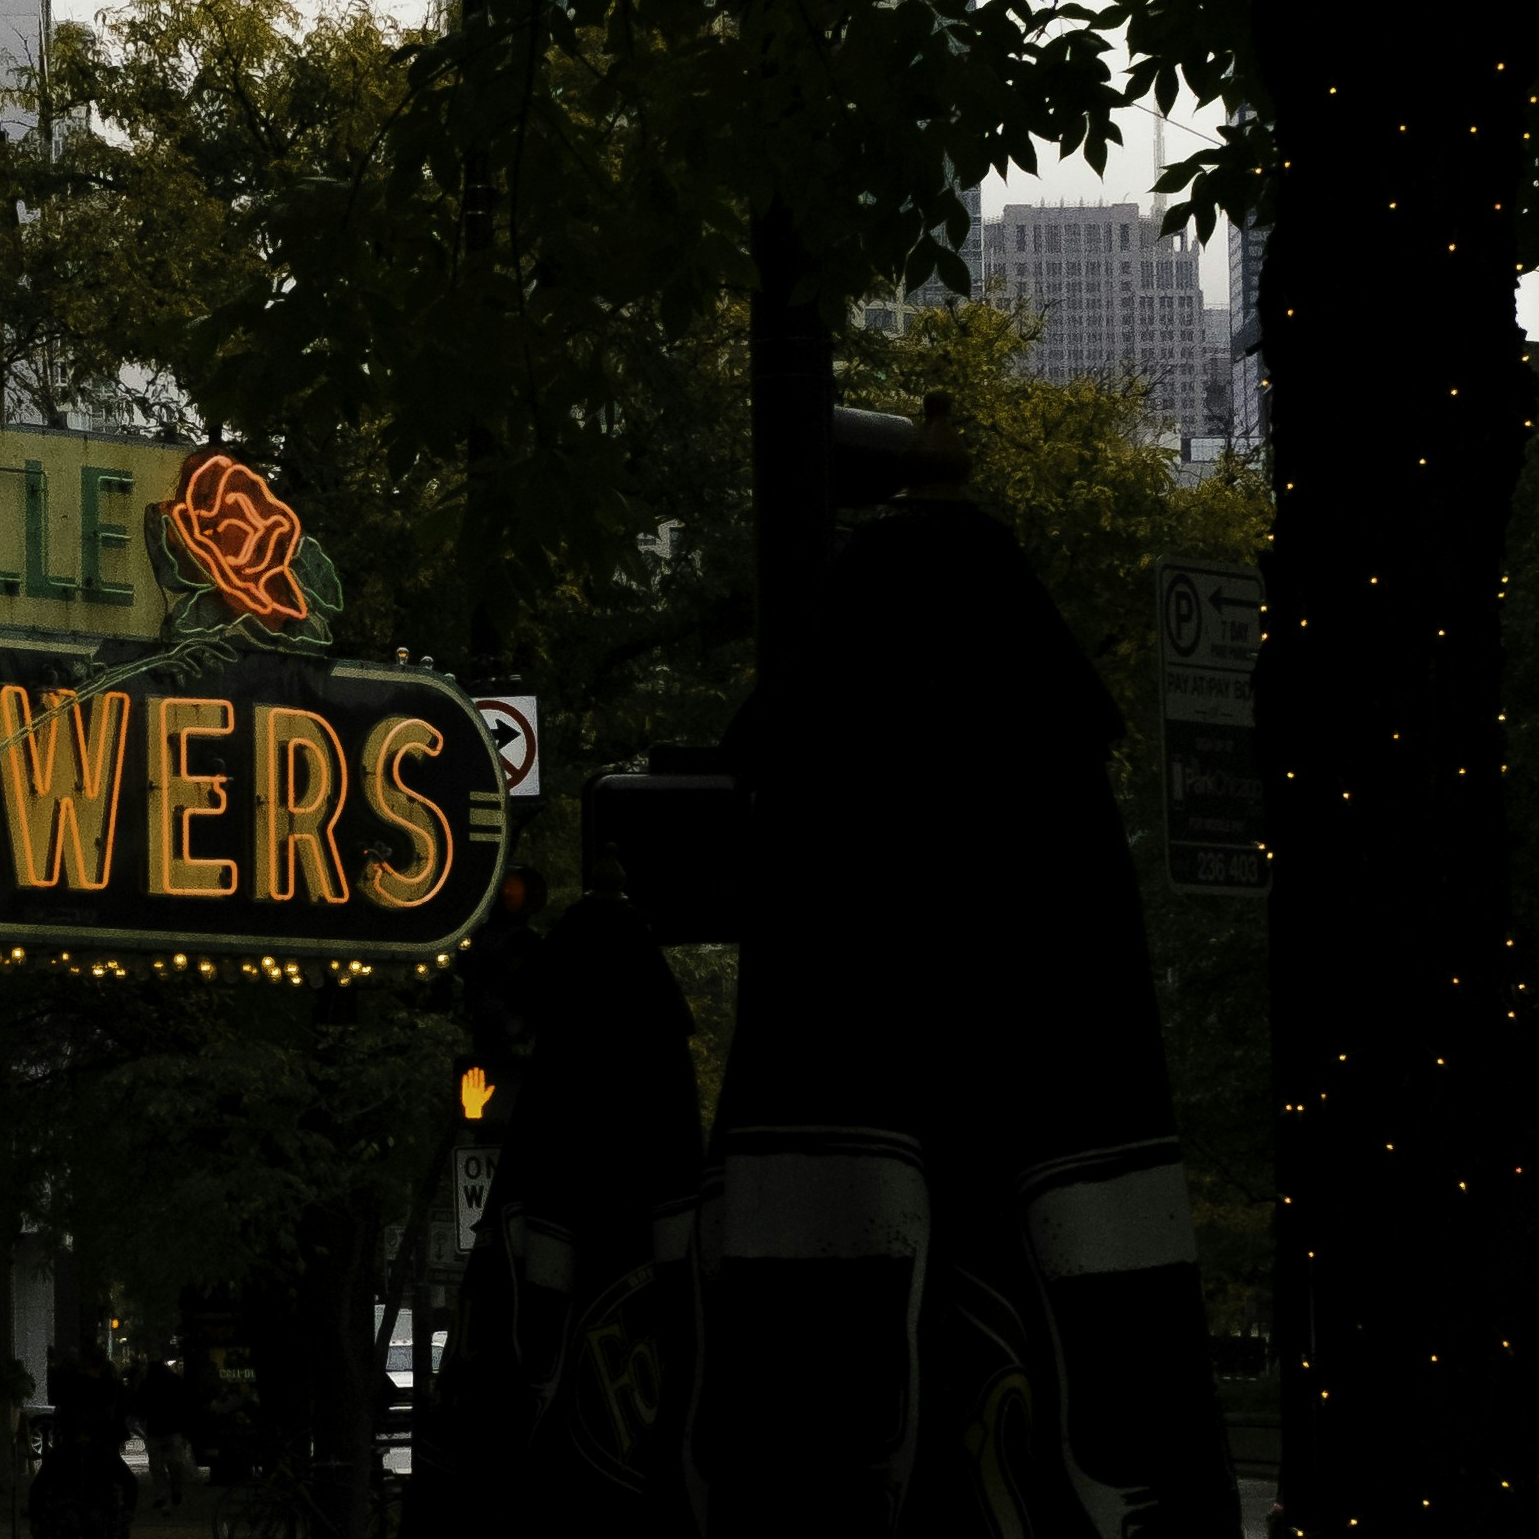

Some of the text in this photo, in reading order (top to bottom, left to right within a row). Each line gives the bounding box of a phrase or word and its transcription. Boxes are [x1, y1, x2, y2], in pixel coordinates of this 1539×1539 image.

[1168, 672, 1190, 694] PAY
[1191, 674, 1208, 696] AT
[1208, 677, 1231, 699] PAY
